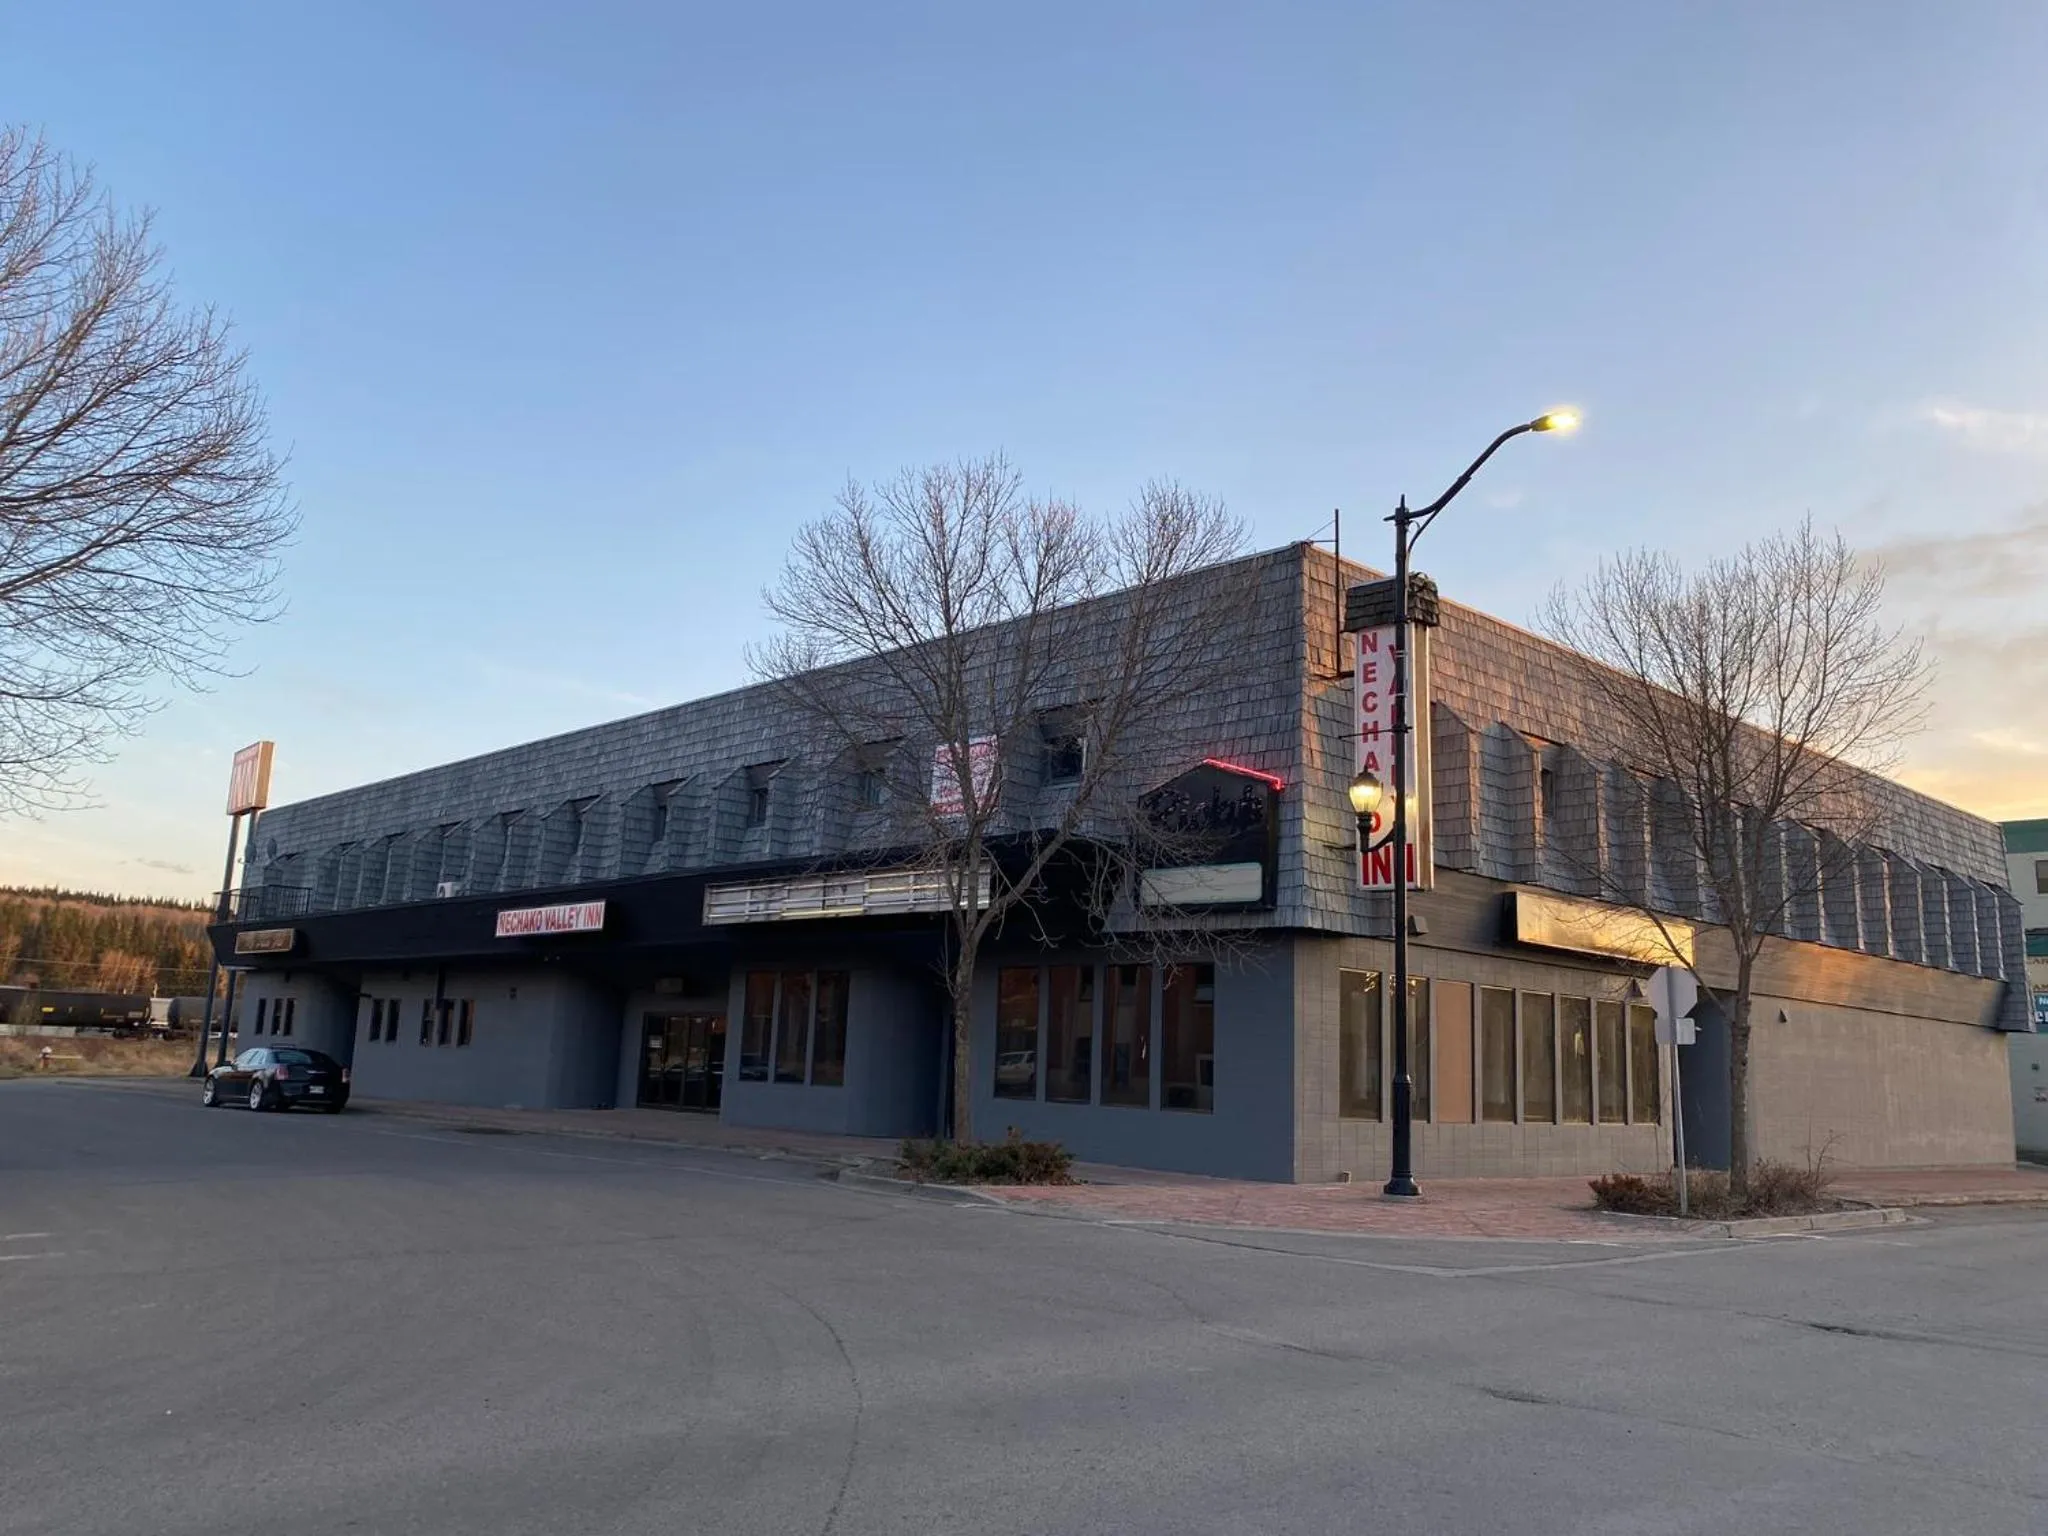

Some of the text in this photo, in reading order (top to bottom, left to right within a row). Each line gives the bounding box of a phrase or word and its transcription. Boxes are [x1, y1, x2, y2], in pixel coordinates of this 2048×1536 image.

[1361, 631, 1382, 833] NECHAO
[499, 903, 602, 933] NECHAKO VALLEY INN
